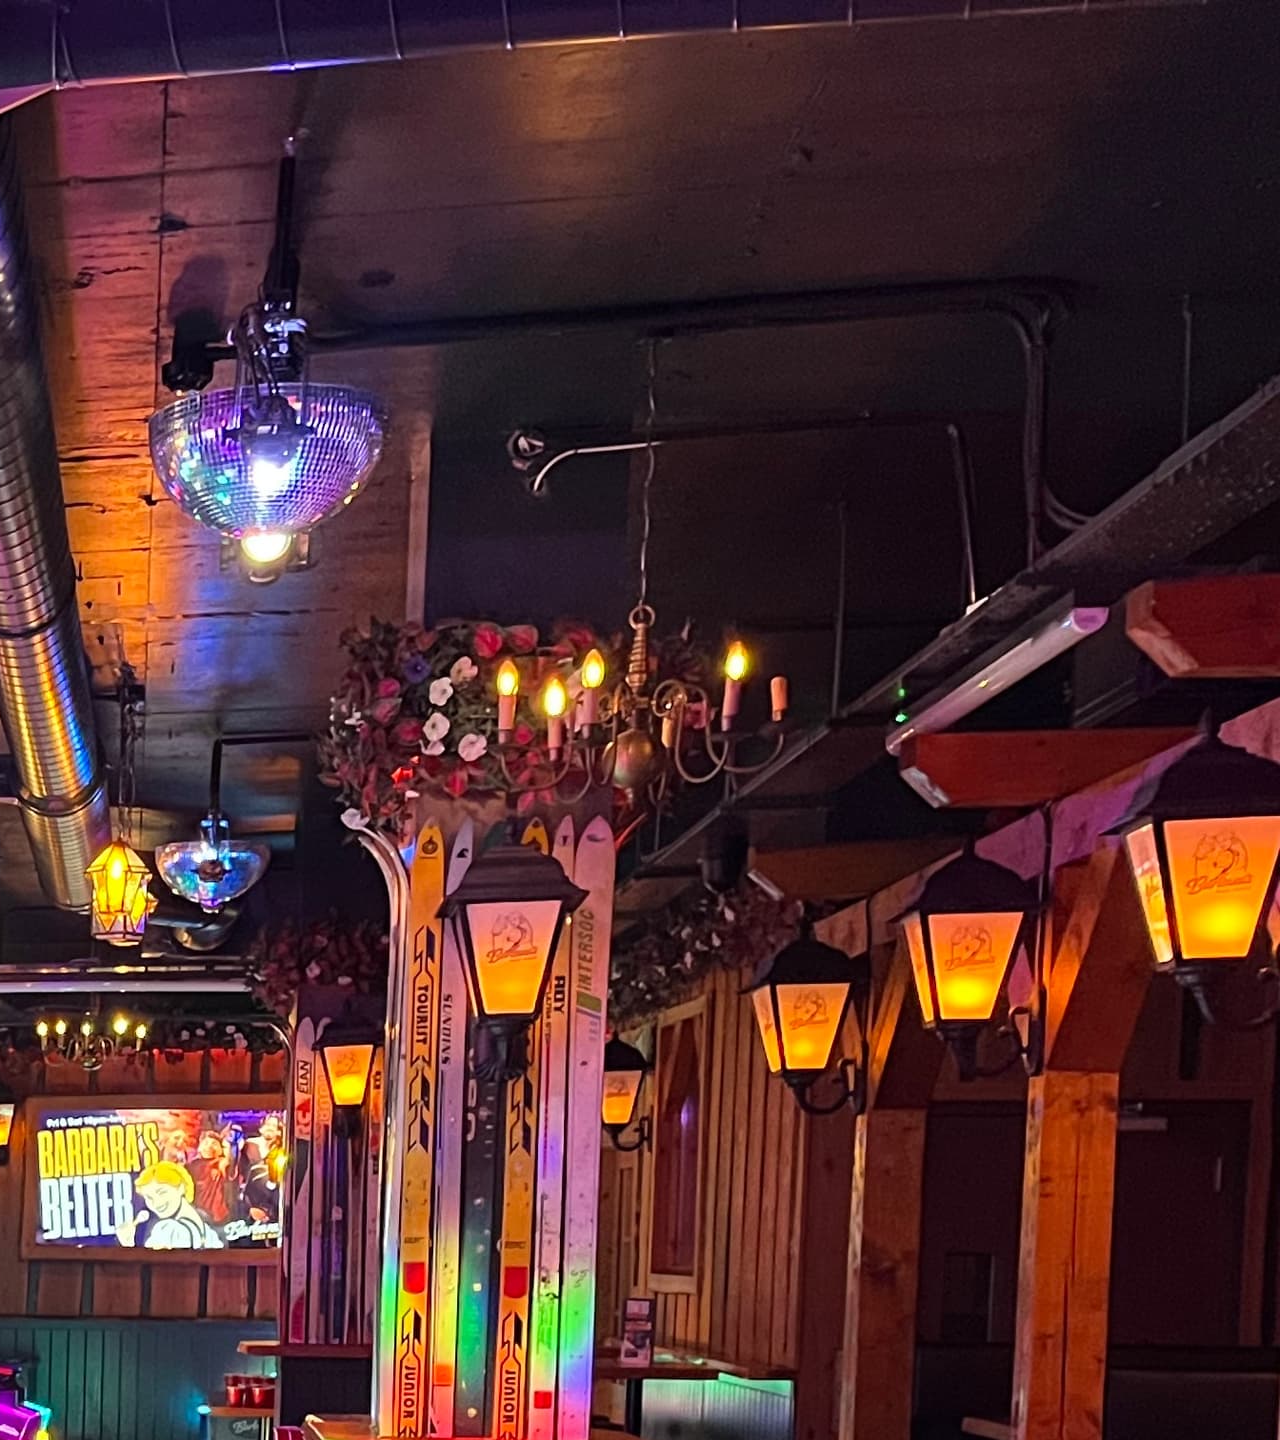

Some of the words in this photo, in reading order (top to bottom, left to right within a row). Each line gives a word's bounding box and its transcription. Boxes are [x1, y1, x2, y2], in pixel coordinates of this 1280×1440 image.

[416, 984, 429, 1045] TOURIST
[298, 1060, 311, 1094] ELAN
[37, 1121, 160, 1178] BARBARA'S
[40, 1173, 135, 1240] BELTER
[403, 1365, 416, 1419] JUNIOR
[503, 1369, 516, 1424] JUNIOR
